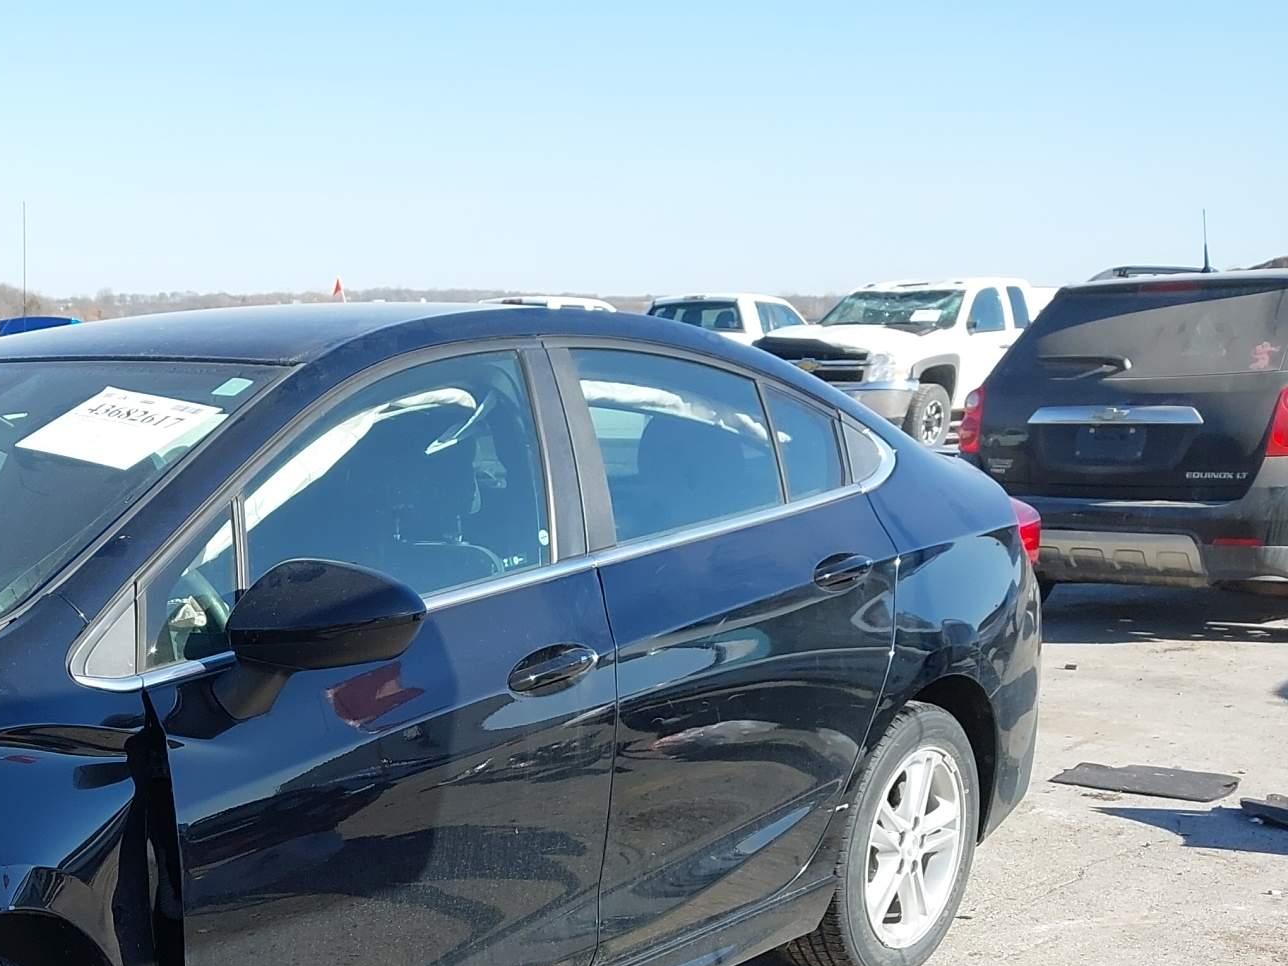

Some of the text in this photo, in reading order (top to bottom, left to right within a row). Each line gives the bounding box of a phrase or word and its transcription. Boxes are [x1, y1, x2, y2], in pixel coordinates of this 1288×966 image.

[87, 402, 184, 429] 43682617
[1185, 471, 1248, 479] EQUINOX LT
